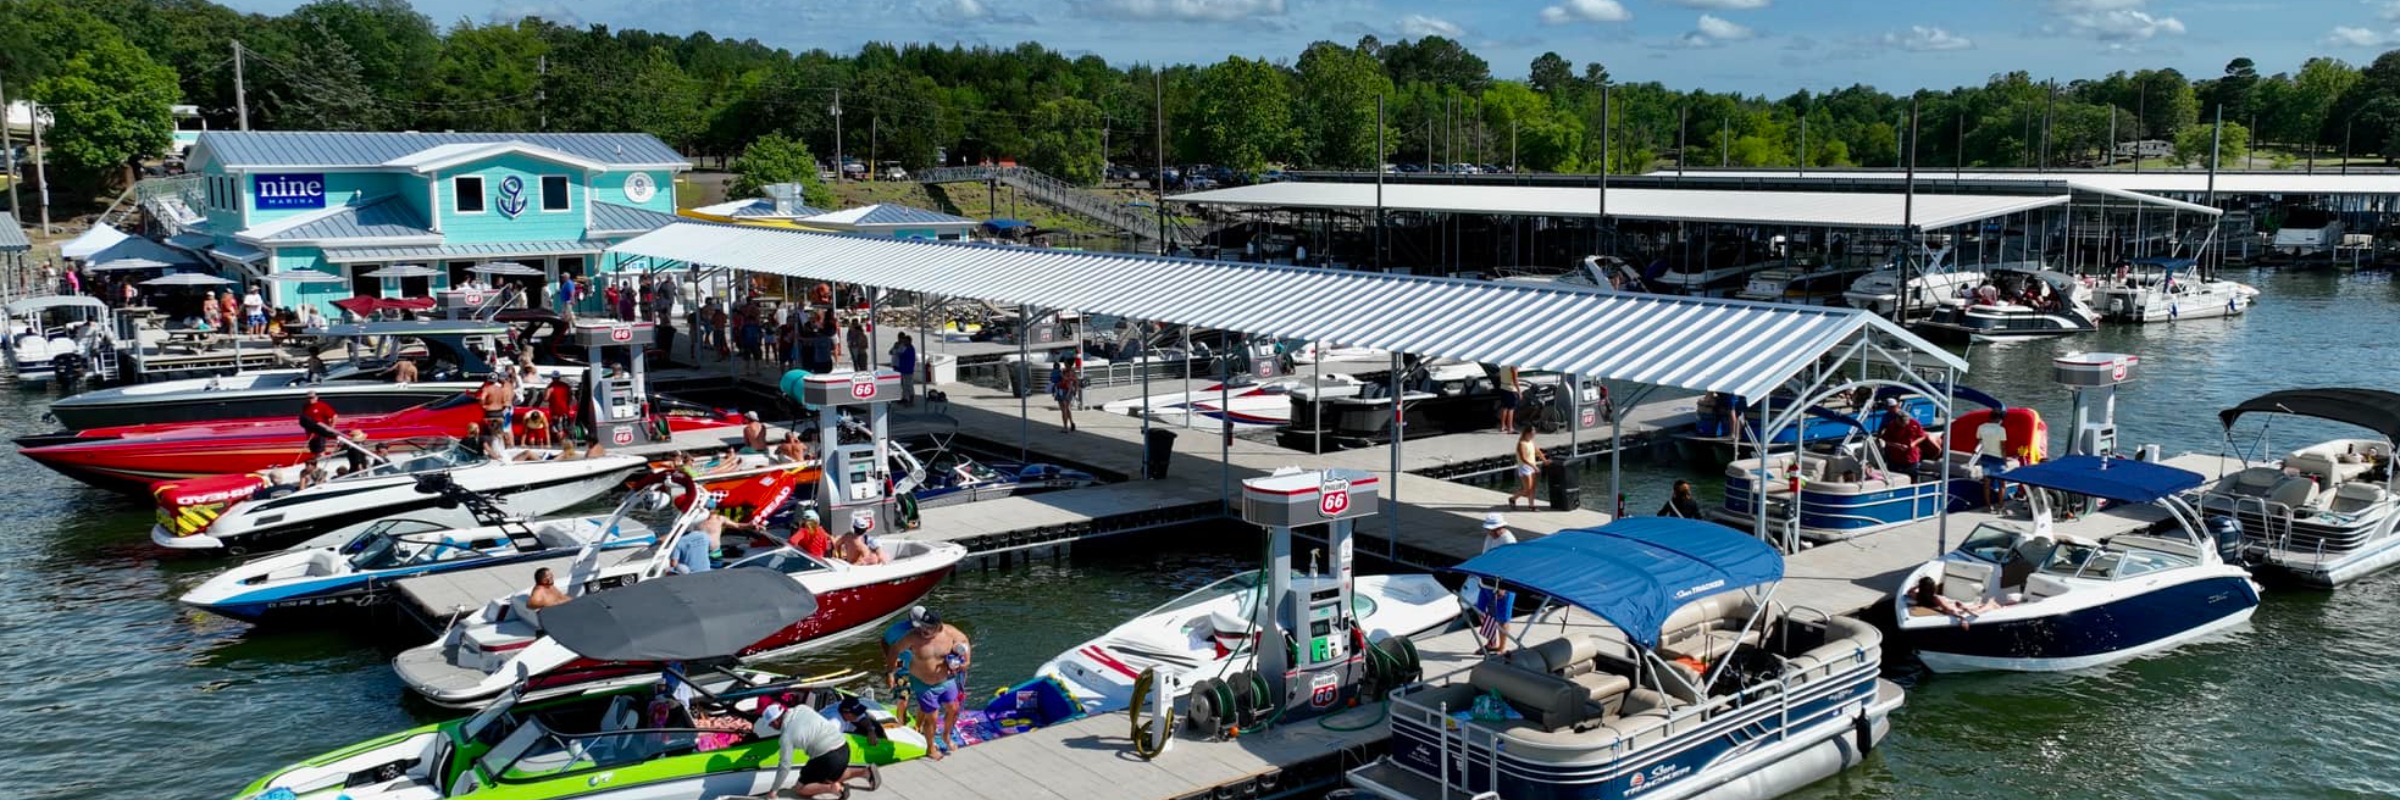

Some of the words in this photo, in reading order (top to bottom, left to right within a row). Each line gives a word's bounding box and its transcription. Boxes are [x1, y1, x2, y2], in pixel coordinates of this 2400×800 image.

[259, 176, 322, 197] nine
[615, 330, 629, 339] 66
[855, 384, 872, 395] 66
[616, 433, 630, 441] 66
[1324, 482, 1347, 492] PHILLIPS
[1325, 493, 1345, 510] 66
[1316, 687, 1334, 704] 66
[1623, 765, 1691, 797] TRACKER
